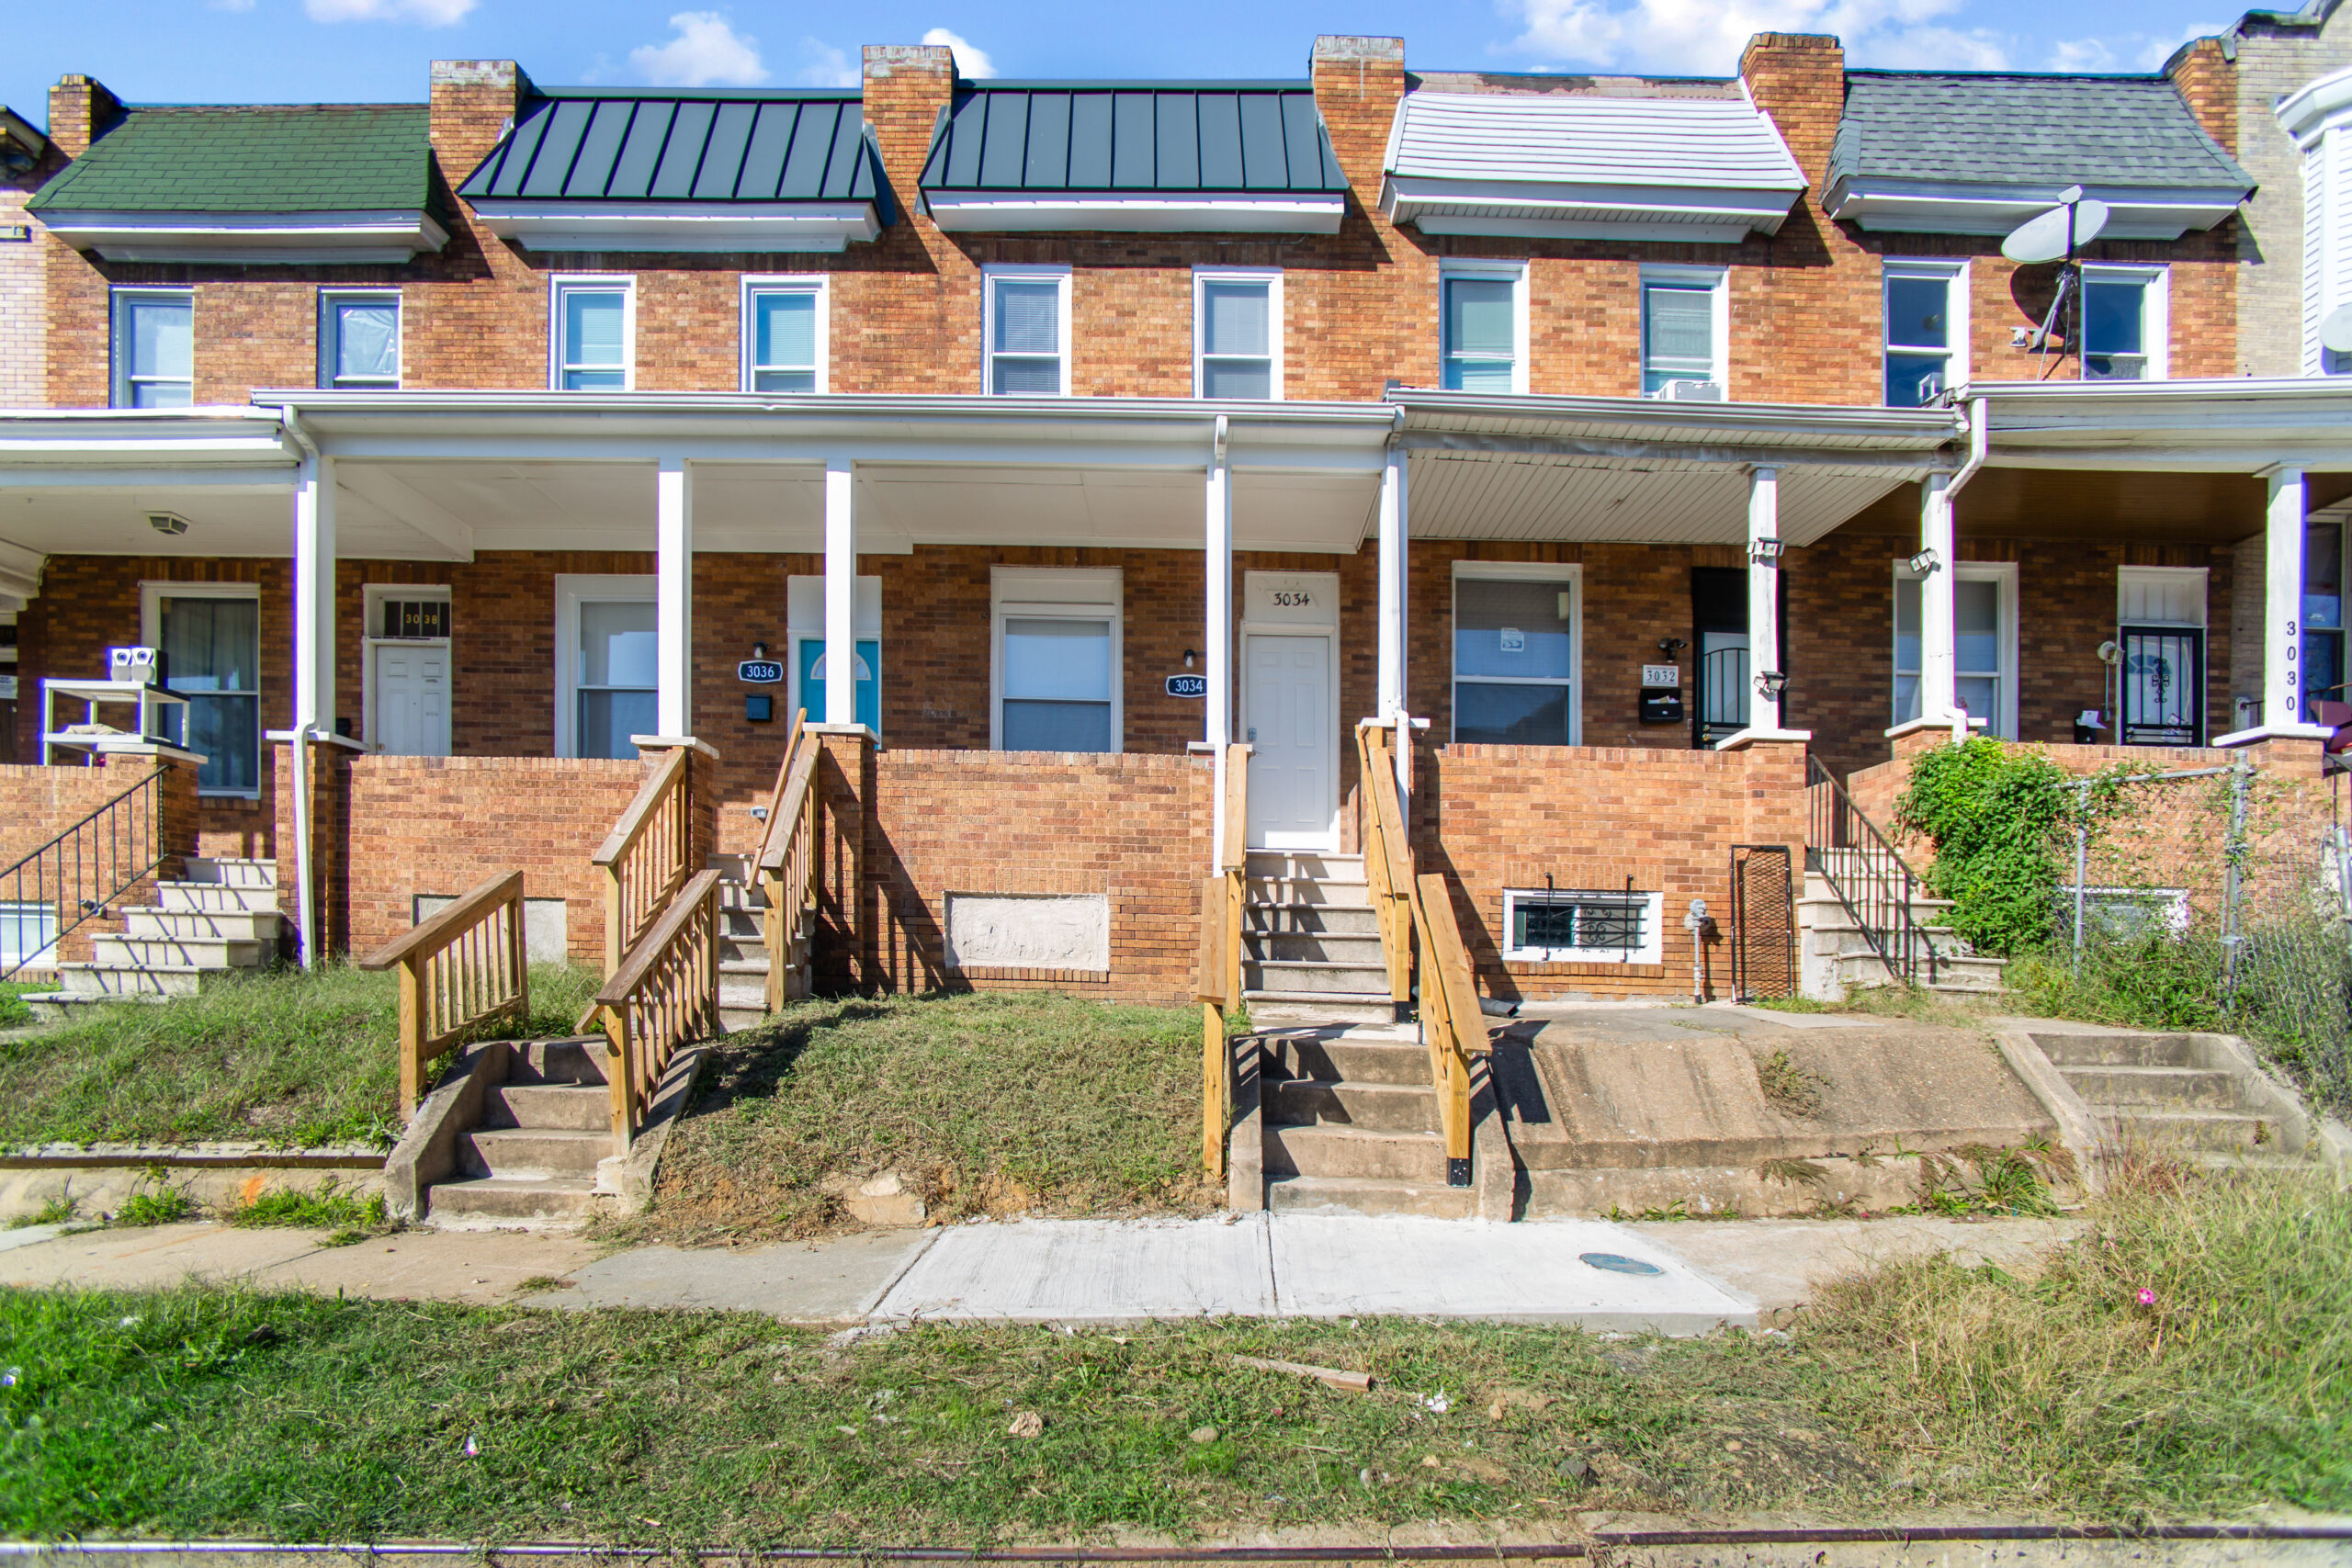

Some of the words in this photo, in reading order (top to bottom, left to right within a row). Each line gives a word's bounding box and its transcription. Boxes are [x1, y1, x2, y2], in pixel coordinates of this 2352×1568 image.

[1272, 592, 1310, 607] 3034
[746, 665, 775, 678] 3036
[2286, 620, 2297, 711] 3030
[1646, 670, 1676, 682] 3032
[1175, 679, 1204, 693] 3034
